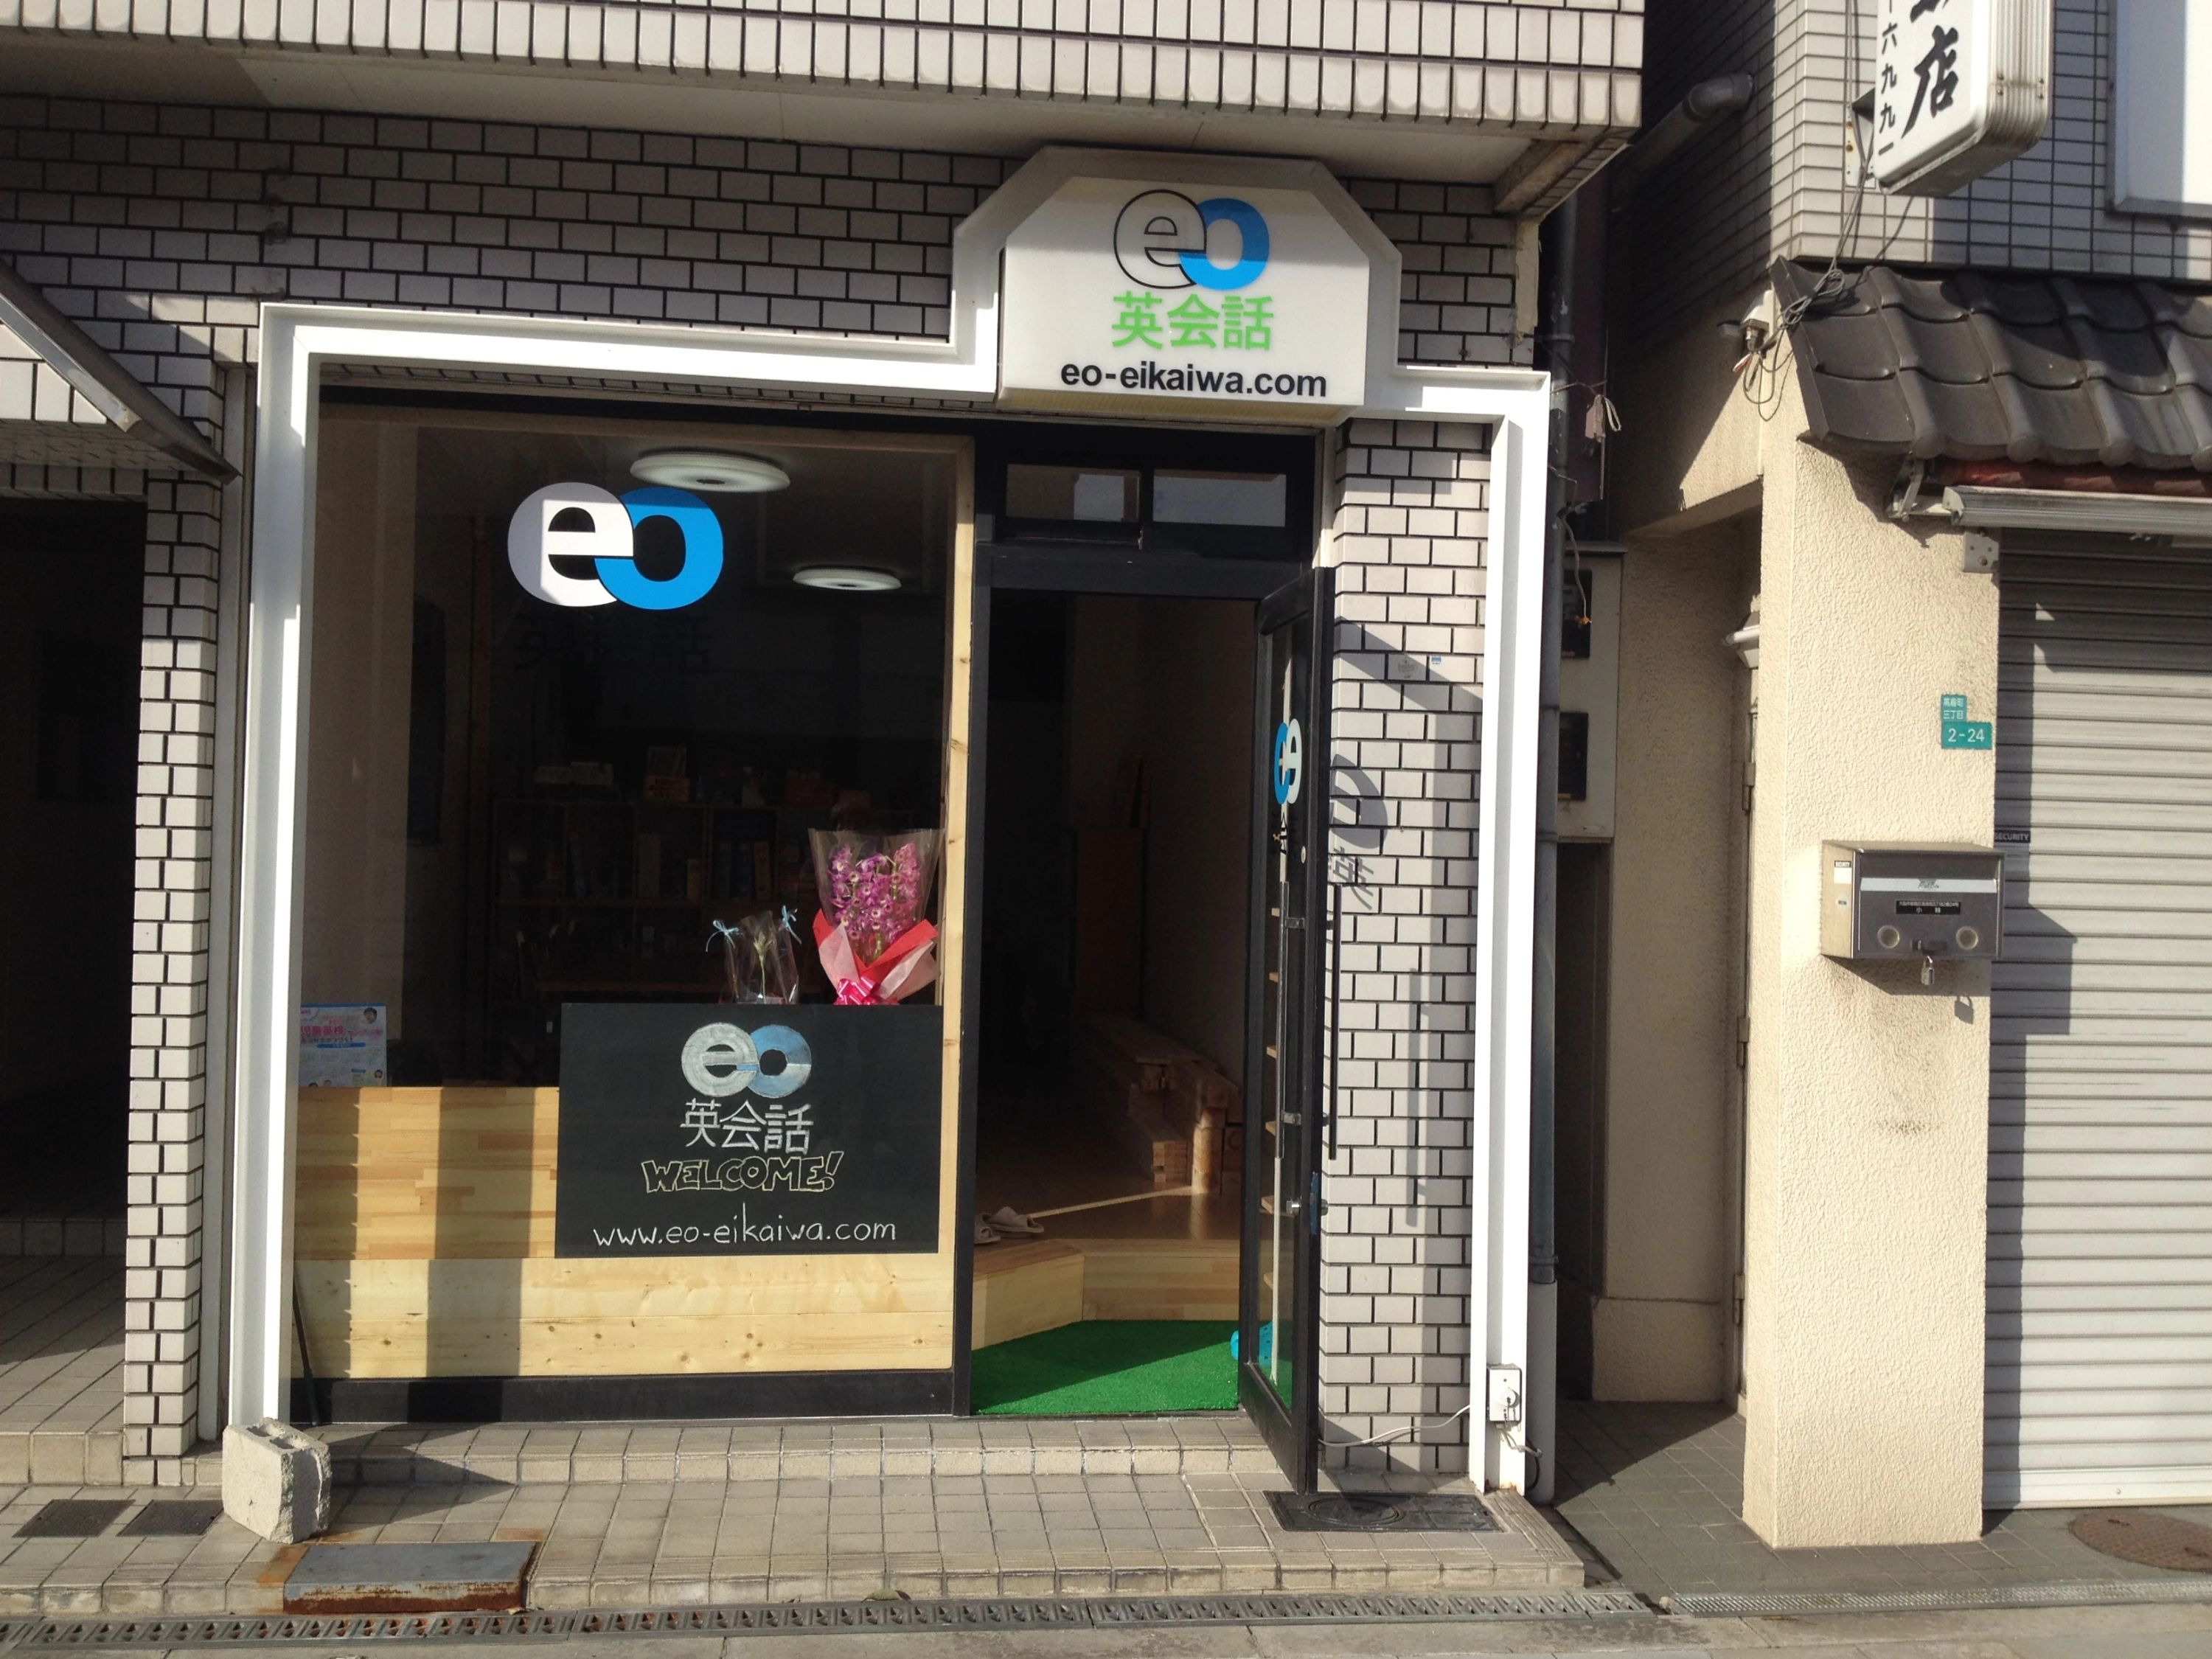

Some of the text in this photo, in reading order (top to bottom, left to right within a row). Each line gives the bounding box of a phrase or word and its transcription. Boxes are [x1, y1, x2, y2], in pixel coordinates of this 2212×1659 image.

[1901, 0, 1959, 139] 店
[1113, 189, 1270, 291] eo
[1111, 290, 1274, 351] 英会話
[1060, 361, 1326, 397] eo-eikaiwa.com
[507, 481, 724, 610] eo
[1948, 728, 1985, 742] 2-24
[681, 1021, 812, 1099] eo
[679, 1098, 814, 1156] 英会話
[640, 1150, 844, 1193] WELCOME!
[593, 1202, 897, 1246] www.eo-eikaiwa.com
